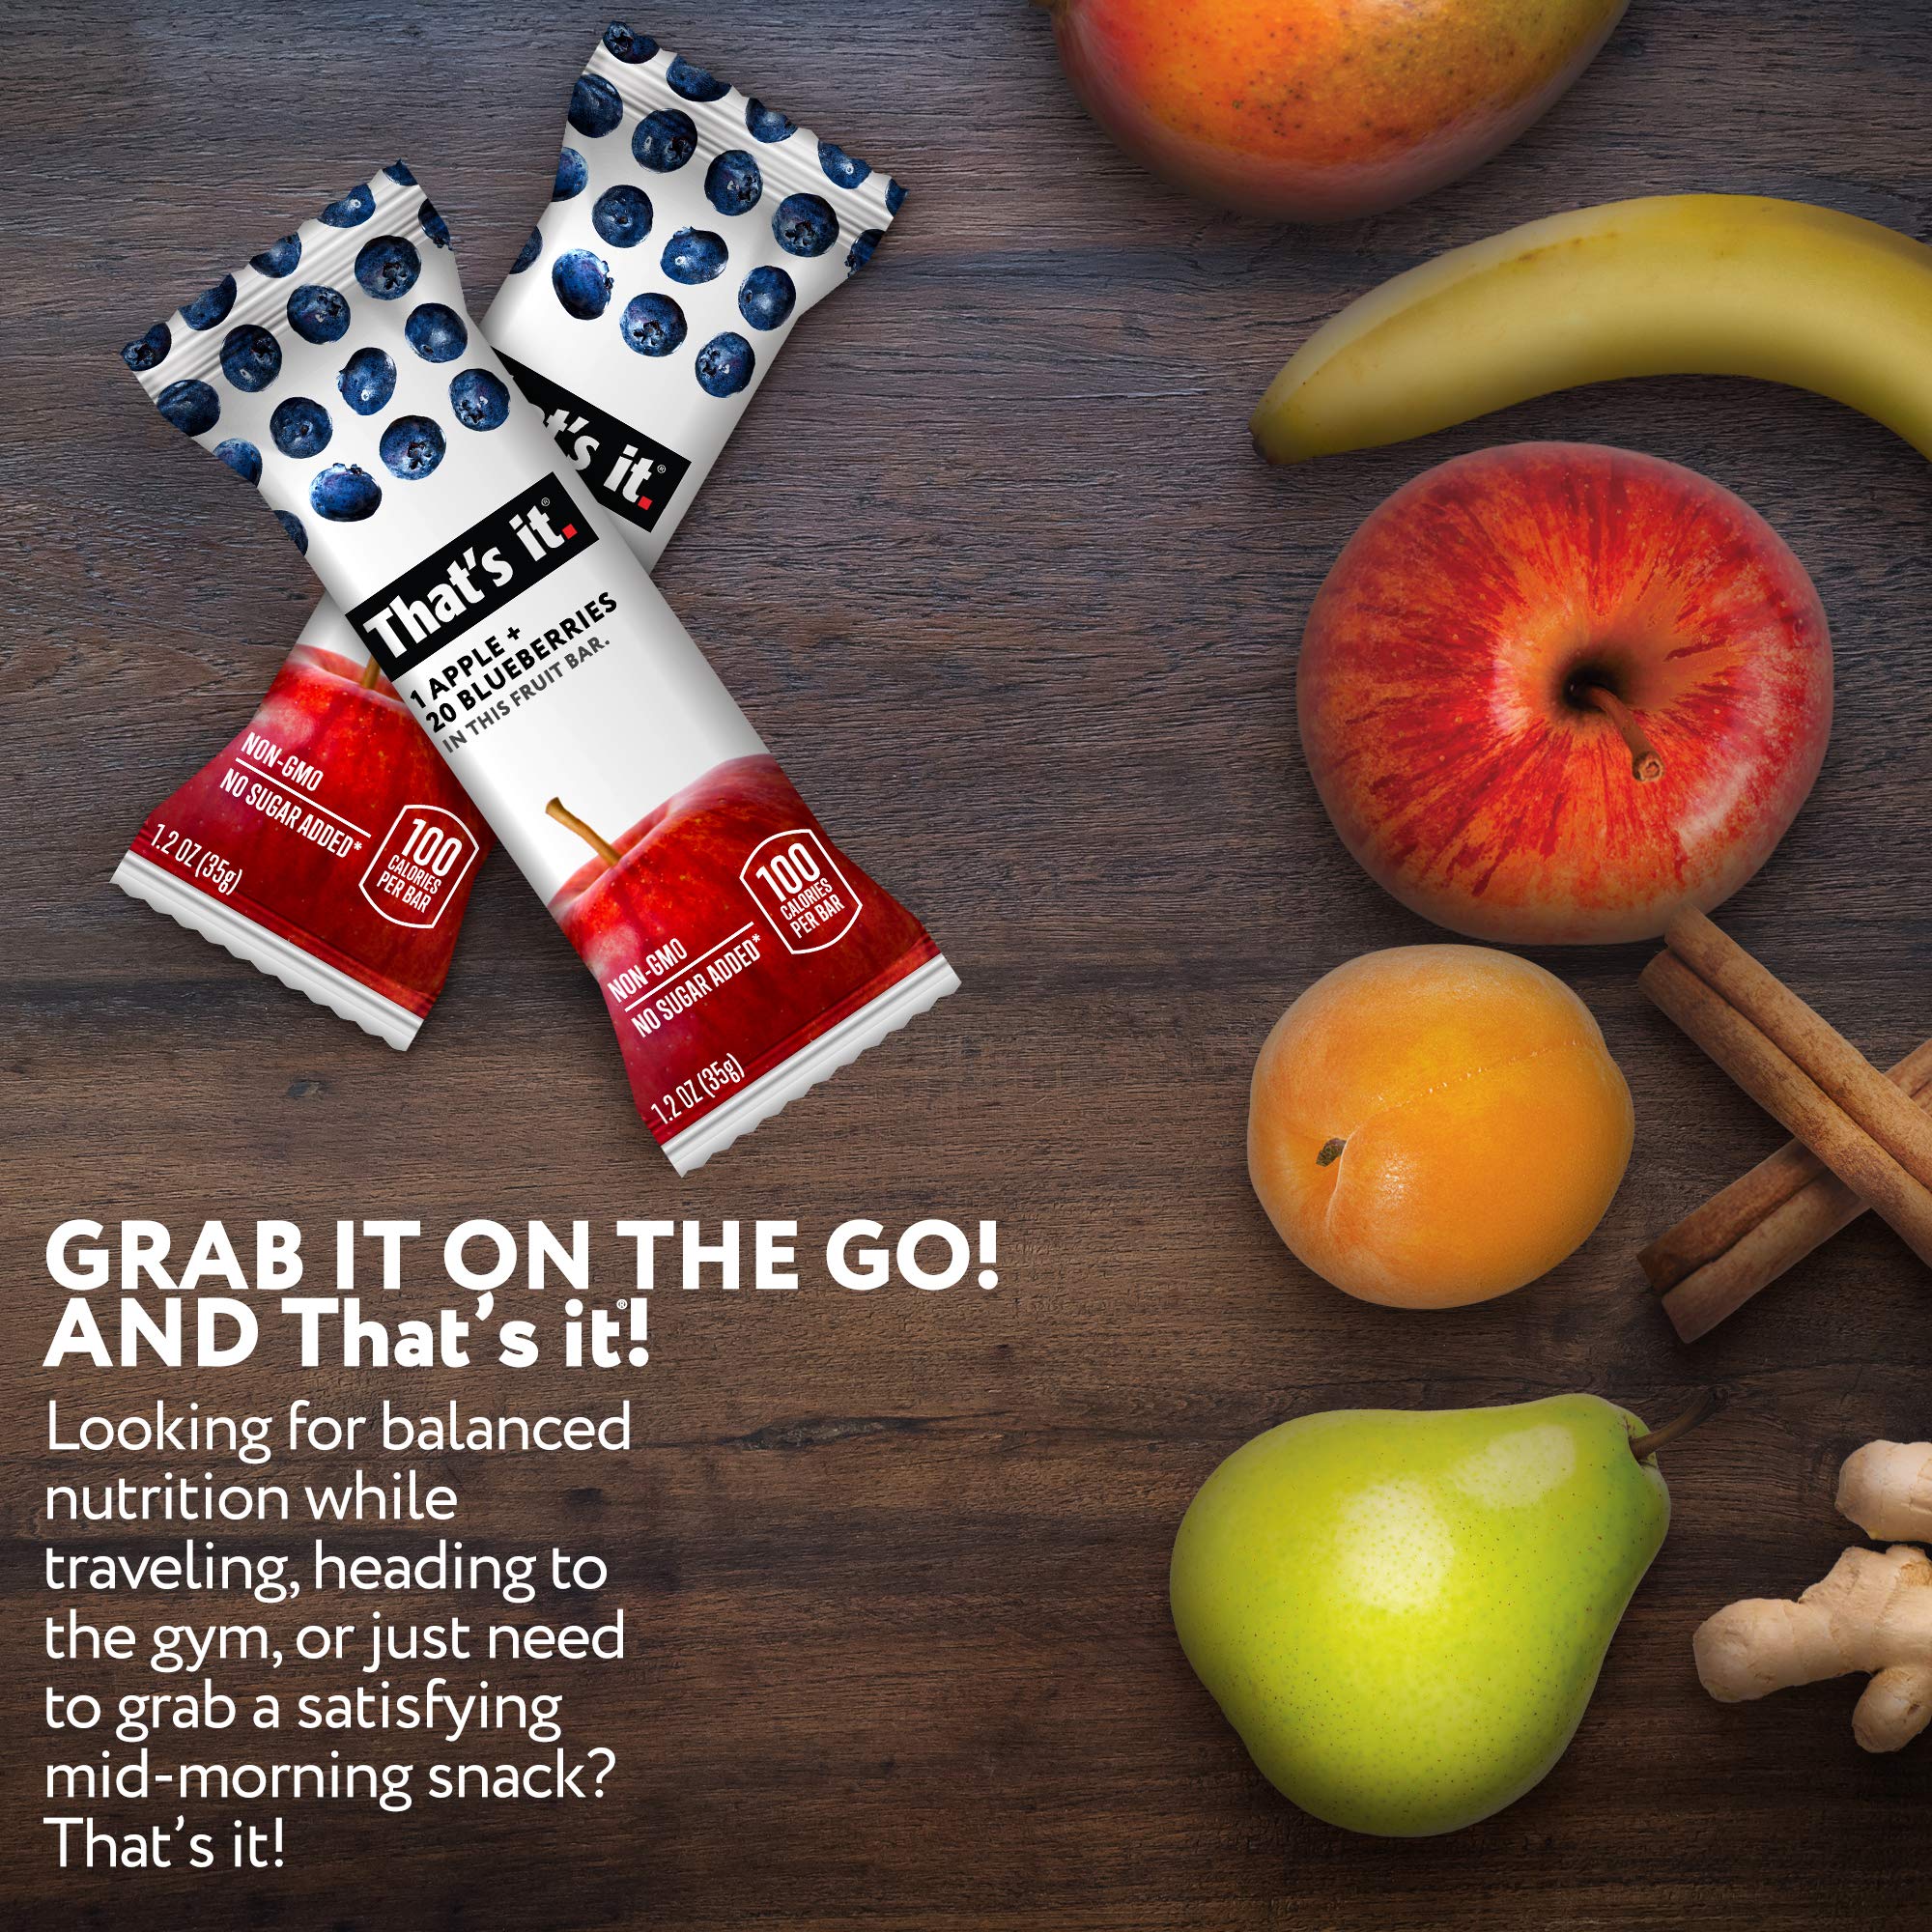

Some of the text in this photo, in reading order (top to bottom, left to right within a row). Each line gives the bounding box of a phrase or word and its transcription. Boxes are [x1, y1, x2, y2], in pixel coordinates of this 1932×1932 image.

[363, 546, 514, 658] That's
[410, 626, 521, 708] 1 APPLE +
[425, 591, 617, 733] 20 BLUEBERRIES
[442, 637, 611, 753] IN THIS FRUIT BAR.
[241, 731, 324, 792] NON-GMO
[219, 767, 243, 798] NO
[245, 782, 298, 830] SUGAR
[150, 824, 243, 895] 1.2 OZ (35g)
[386, 854, 442, 895] CALORIES
[401, 817, 462, 877] 100
[755, 842, 820, 901] 100
[376, 870, 432, 913] PER BAR
[780, 877, 833, 921] CALORIES
[789, 894, 845, 939] PER BAR
[607, 938, 688, 1003] NON-GMO
[631, 1009, 661, 1038] NO
[663, 971, 715, 1022] SUGAR
[651, 1052, 746, 1125] 1.2 OZ (35g)
